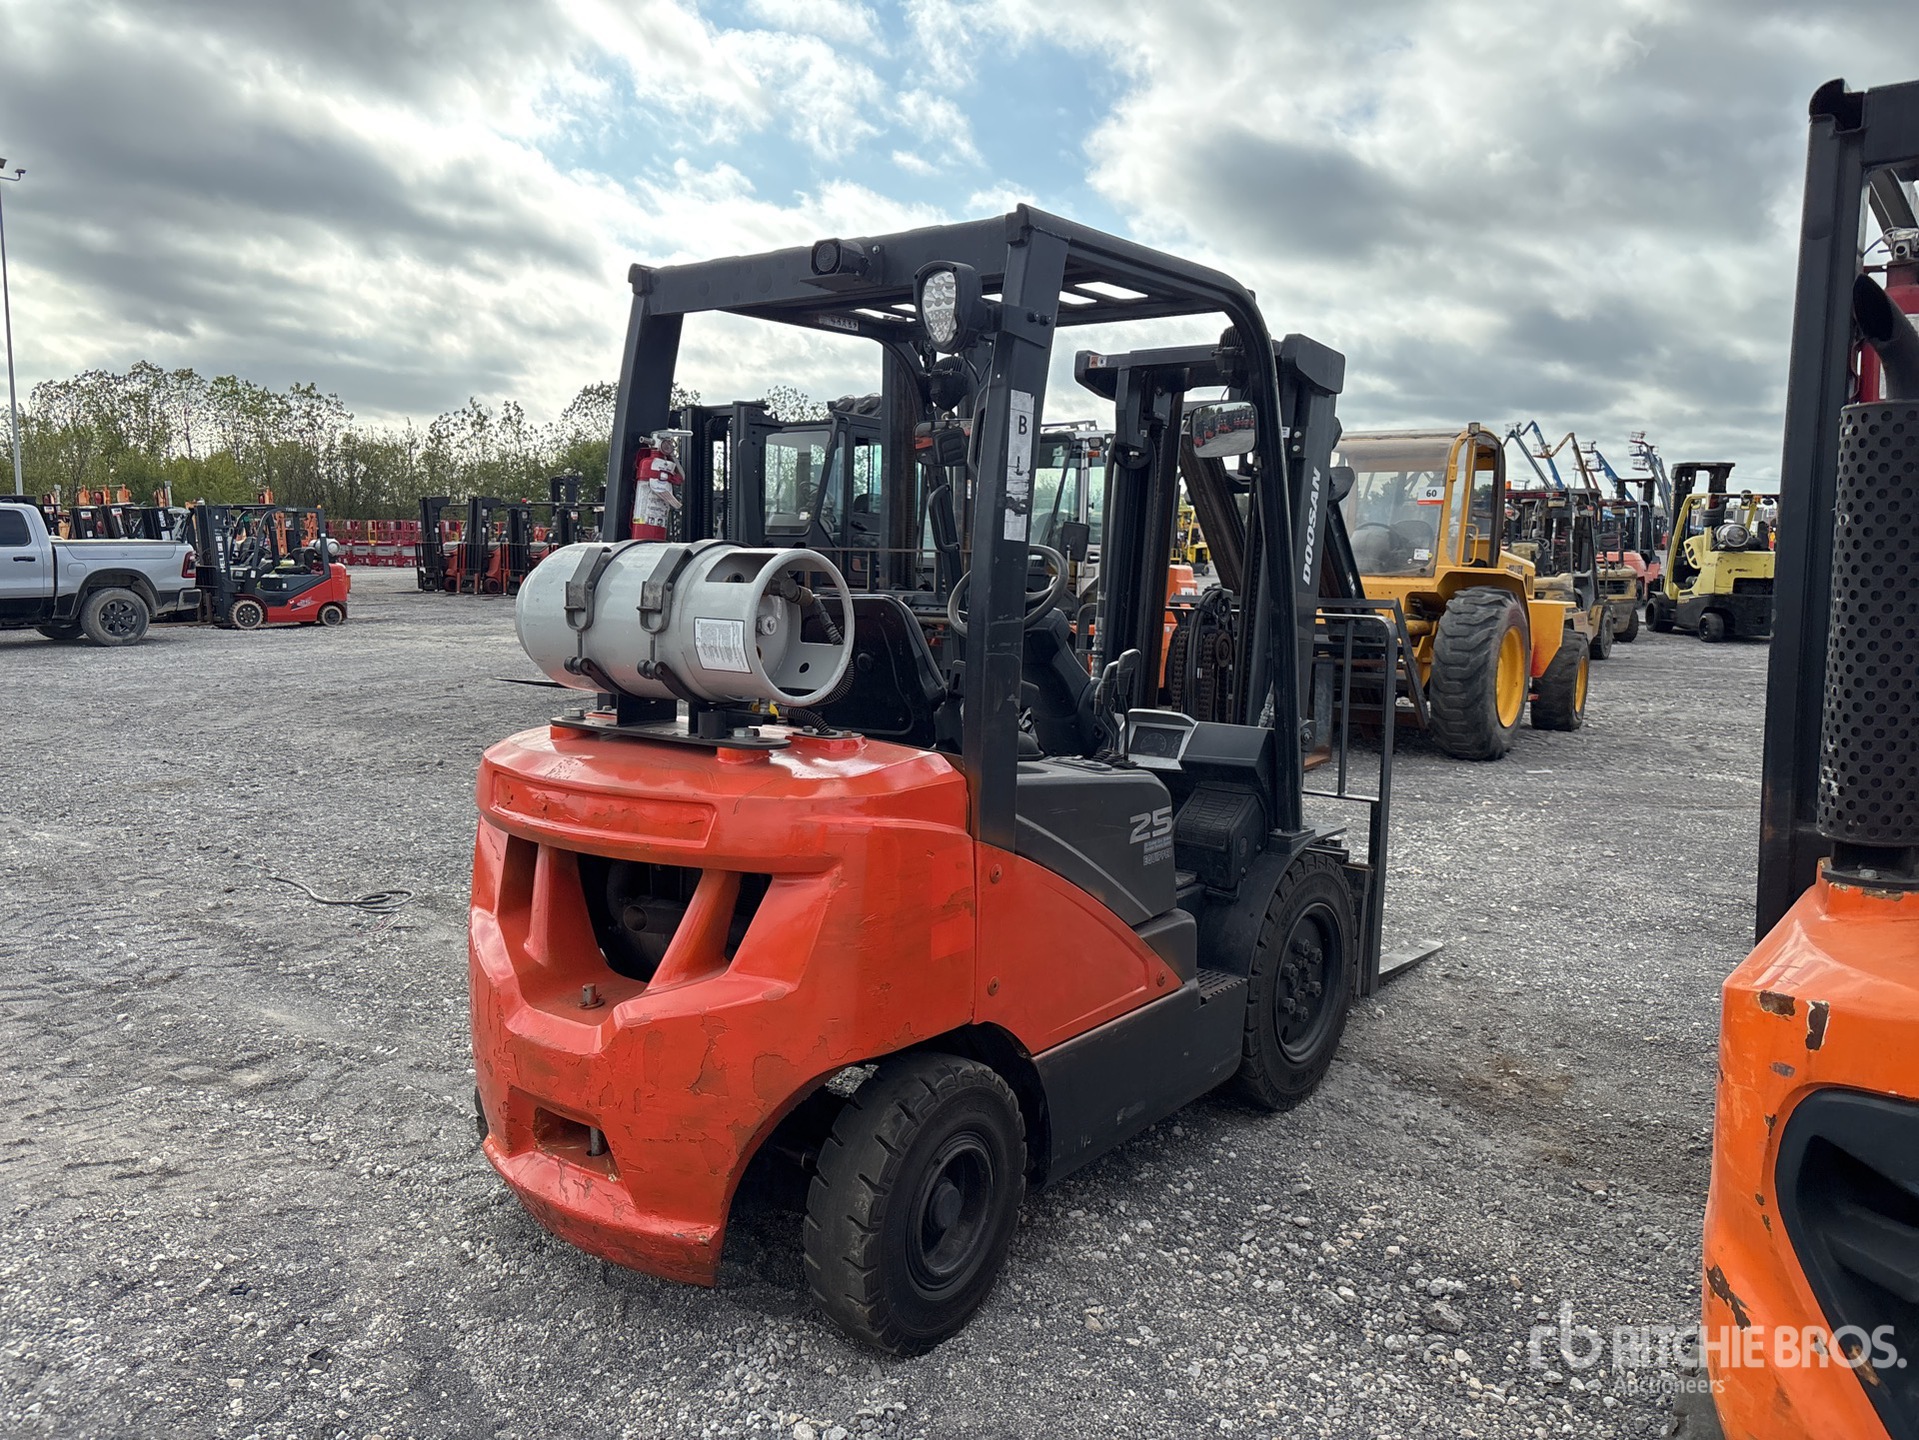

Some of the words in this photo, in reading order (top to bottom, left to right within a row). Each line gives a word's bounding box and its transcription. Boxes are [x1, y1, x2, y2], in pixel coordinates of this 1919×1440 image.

[1426, 489, 1438, 498] 60
[1302, 466, 1321, 586] DOOSAN
[1129, 806, 1172, 844] 25
